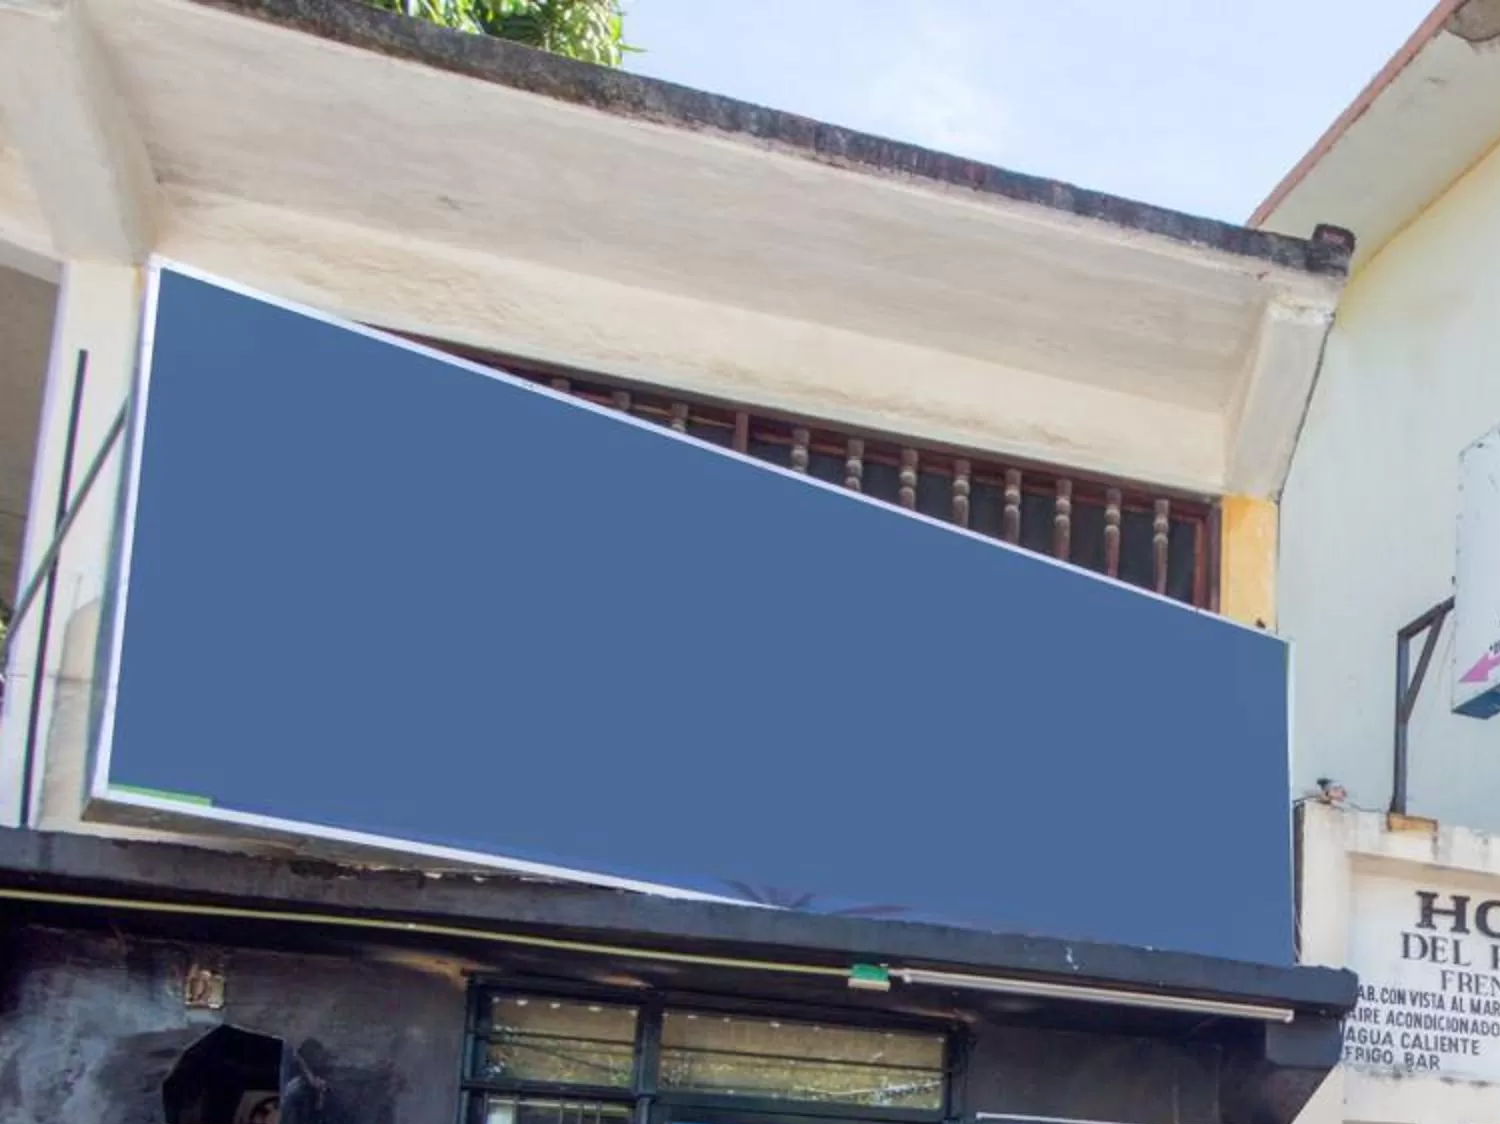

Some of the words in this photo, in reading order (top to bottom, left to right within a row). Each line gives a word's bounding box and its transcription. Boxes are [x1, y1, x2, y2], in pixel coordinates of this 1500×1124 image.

[1400, 931, 1471, 967] DEL
[1357, 984, 1378, 1002] AB.
[1380, 987, 1406, 1006] CON
[1408, 989, 1445, 1011] VISTA
[1450, 995, 1466, 1014] AL
[1470, 997, 1500, 1018] MAR
[1350, 1006, 1381, 1025] AIRE
[1385, 1010, 1500, 1037] ACONDICIONADO
[1345, 1025, 1394, 1048] AGUA
[1400, 1031, 1481, 1056] CALIENTE
[1344, 1045, 1394, 1065] FRIGO
[1403, 1051, 1441, 1071] BAR
